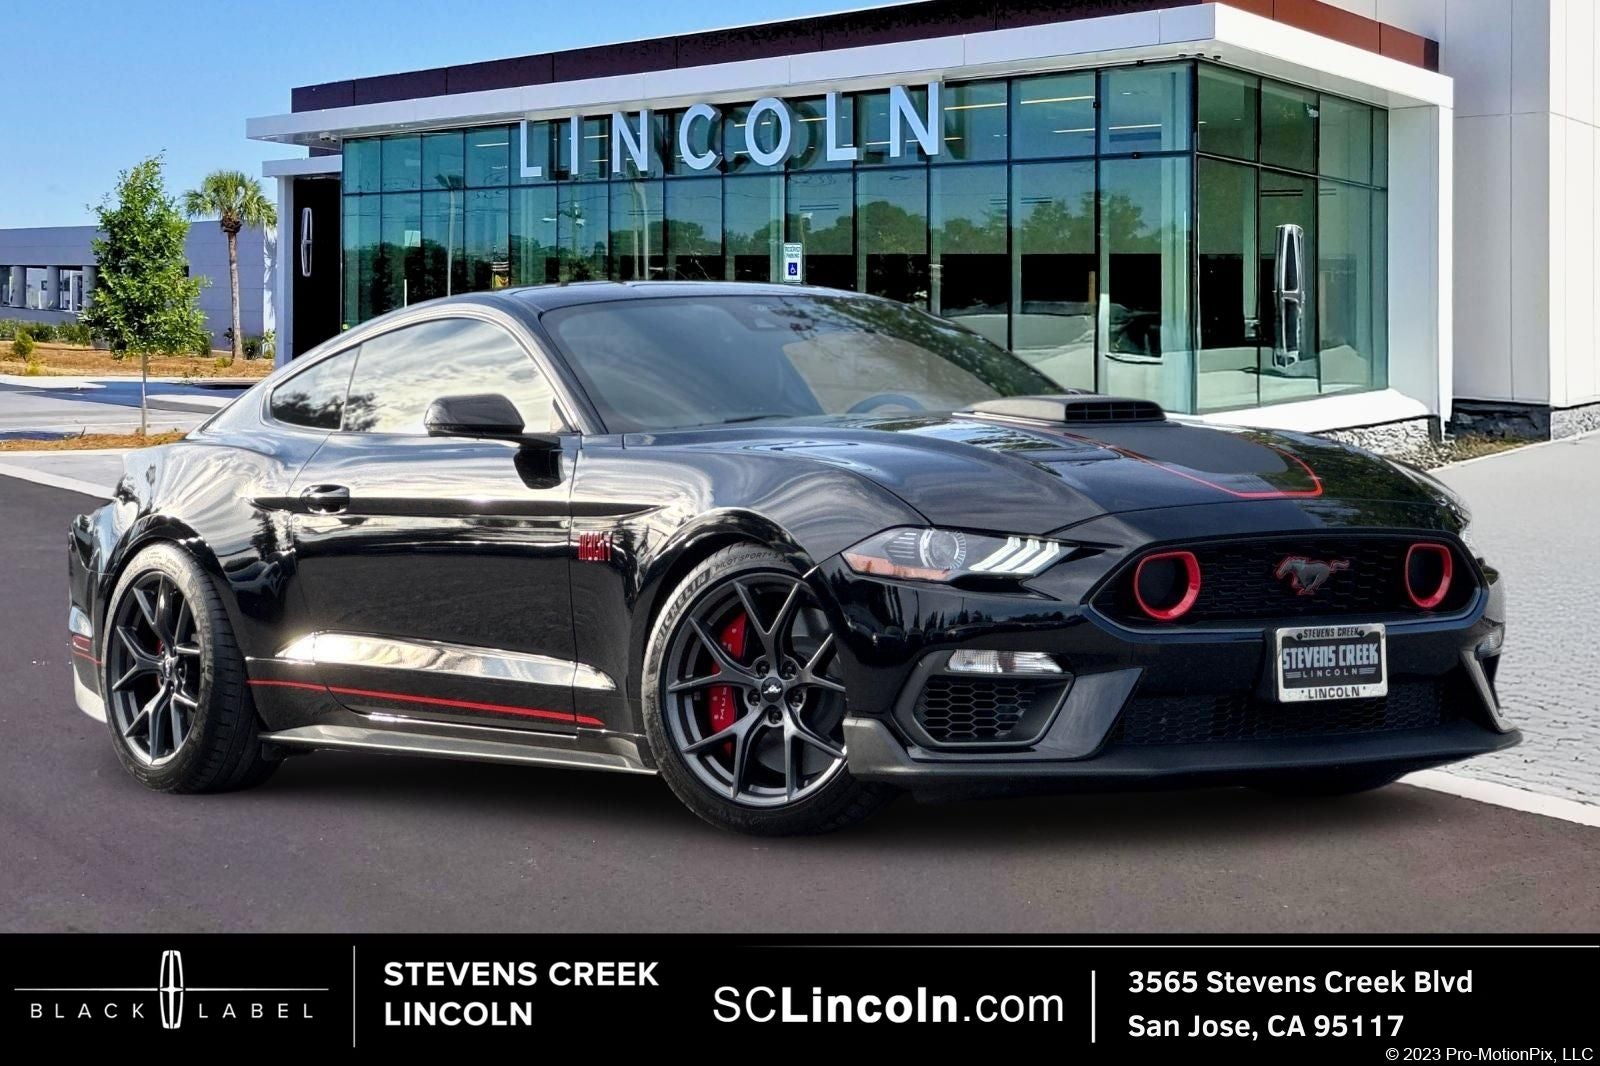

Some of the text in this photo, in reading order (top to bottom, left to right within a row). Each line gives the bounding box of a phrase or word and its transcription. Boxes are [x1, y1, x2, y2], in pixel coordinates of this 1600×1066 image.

[520, 81, 942, 178] LINCOLN
[655, 572, 707, 650] MICHELIN
[1303, 626, 1360, 639] STEVENS CREEK
[1339, 643, 1379, 667] CREEK
[1302, 668, 1358, 678] LINCOLN
[1308, 686, 1360, 699] LINCOLN
